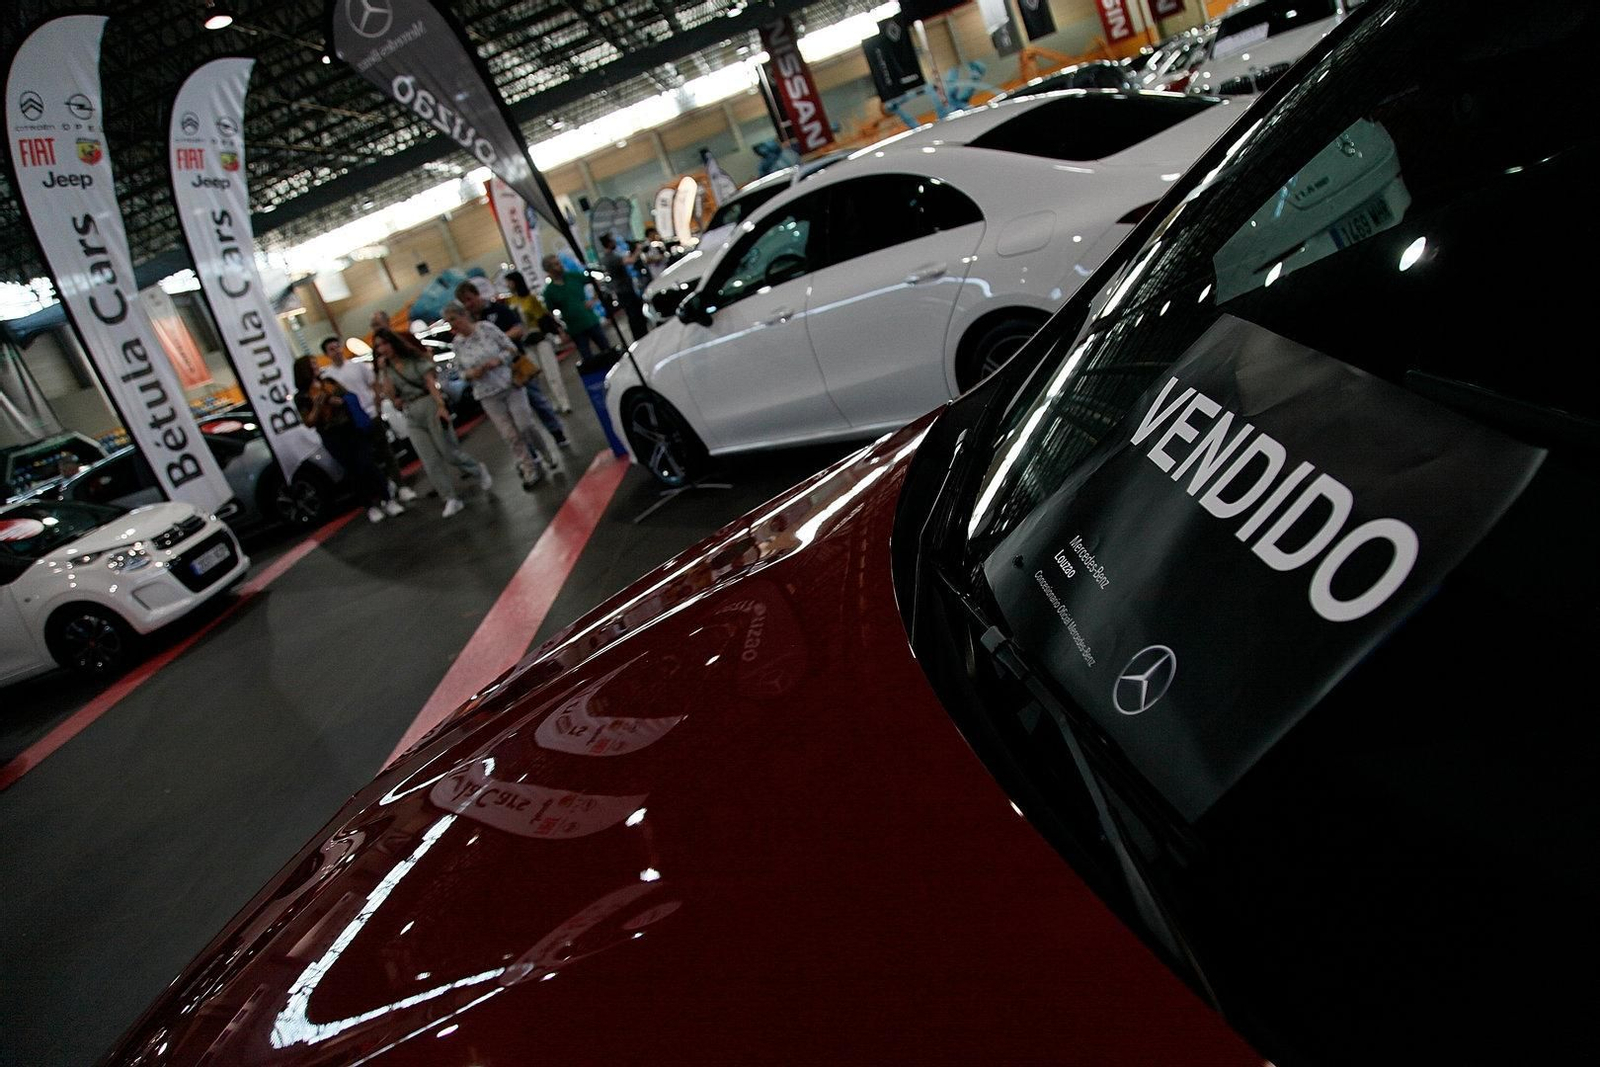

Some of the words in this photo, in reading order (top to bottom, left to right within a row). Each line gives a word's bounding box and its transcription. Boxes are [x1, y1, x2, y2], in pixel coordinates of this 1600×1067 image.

[761, 17, 828, 150] NISSAN
[18, 137, 57, 167] FIAT
[42, 171, 93, 189] Jeep
[176, 148, 206, 171] FIAT
[191, 175, 231, 190] Jeep
[71, 212, 129, 326] Cars
[211, 208, 251, 299] Cars
[238, 310, 301, 436] Bétula
[120, 337, 205, 490] Bétula
[1130, 376, 1420, 623] VENDIDO
[1053, 548, 1077, 579] Louzao
[1069, 534, 1110, 590] Mercedes-Benz
[1066, 620, 1097, 668] Mercedes-Benz
